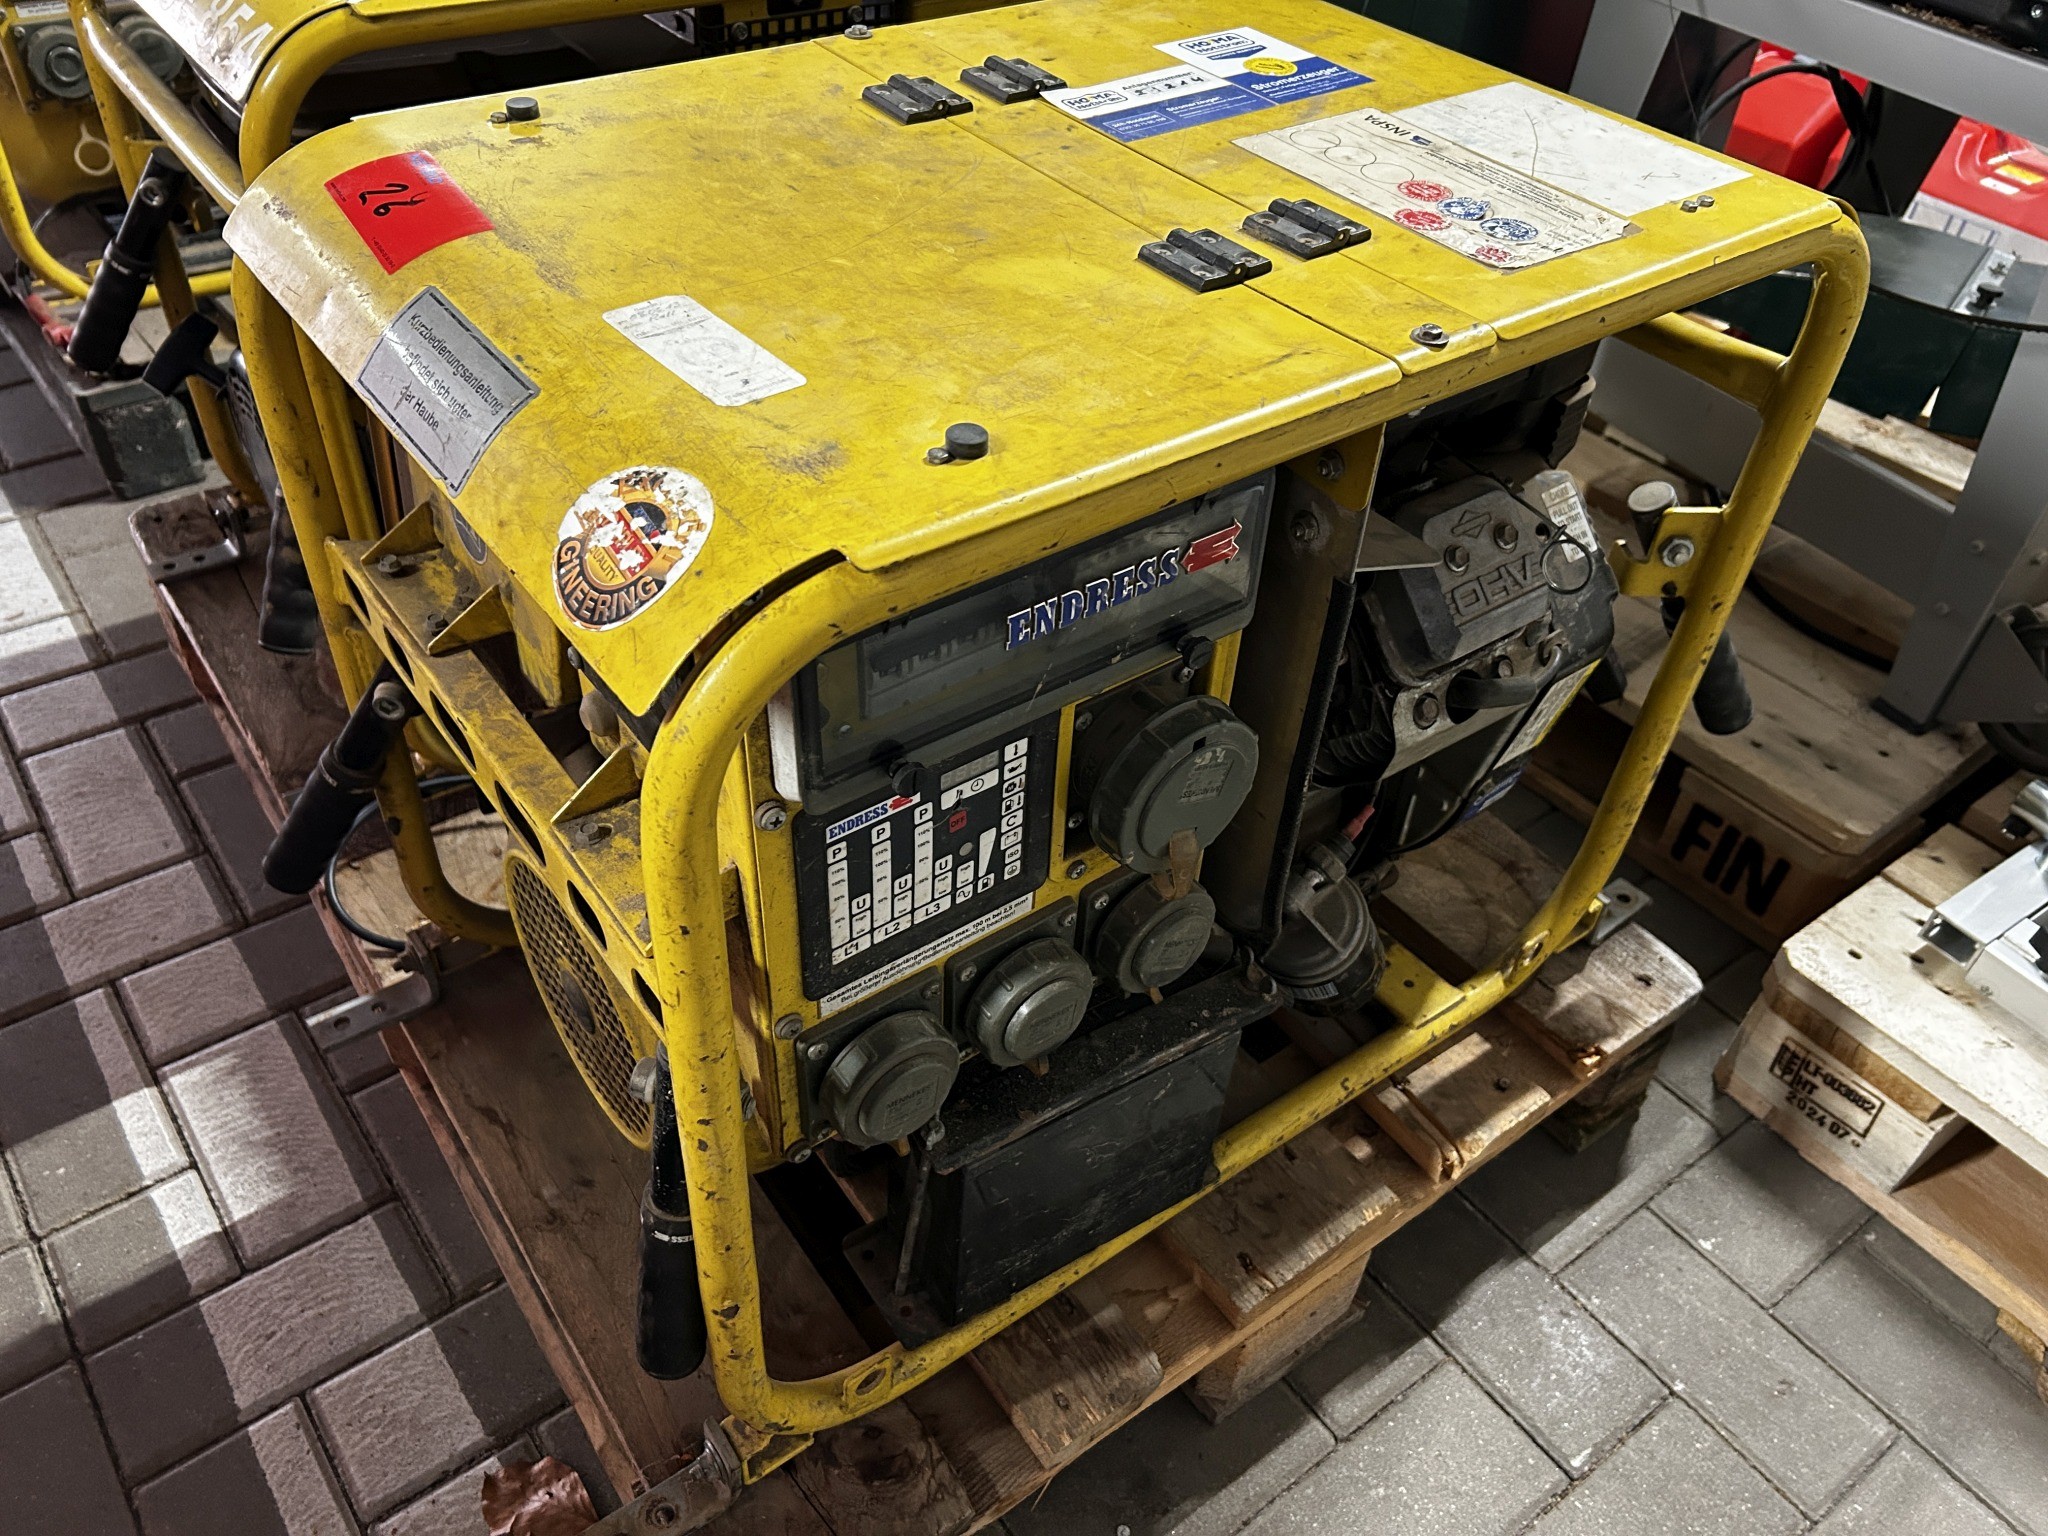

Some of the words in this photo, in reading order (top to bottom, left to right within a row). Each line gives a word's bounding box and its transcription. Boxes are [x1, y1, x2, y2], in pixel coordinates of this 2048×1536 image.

[1250, 65, 1340, 92] Stromerzeuger
[1365, 113, 1414, 138] INSPA
[407, 312, 505, 416] Kurzbedienungsanleitung
[432, 377, 451, 402] sich
[447, 396, 472, 421] unter
[414, 396, 440, 432] Haube
[590, 545, 619, 583] QUALITY
[1006, 547, 1180, 650] ENDRESS
[828, 803, 889, 840] ENDRESS
[919, 807, 928, 820] P
[950, 816, 964, 828] OFF
[876, 827, 886, 840] P
[832, 847, 842, 860] P
[1007, 848, 1019, 858] ISO
[1670, 802, 1791, 918] FIN
[939, 859, 948, 871] U
[898, 878, 908, 890] U
[856, 898, 866, 910] U
[925, 903, 941, 917] L3
[884, 921, 900, 937] L2
[844, 942, 859, 957] L1
[826, 982, 863, 1004] Gesamtes
[1785, 1090, 1828, 1127] 2024
